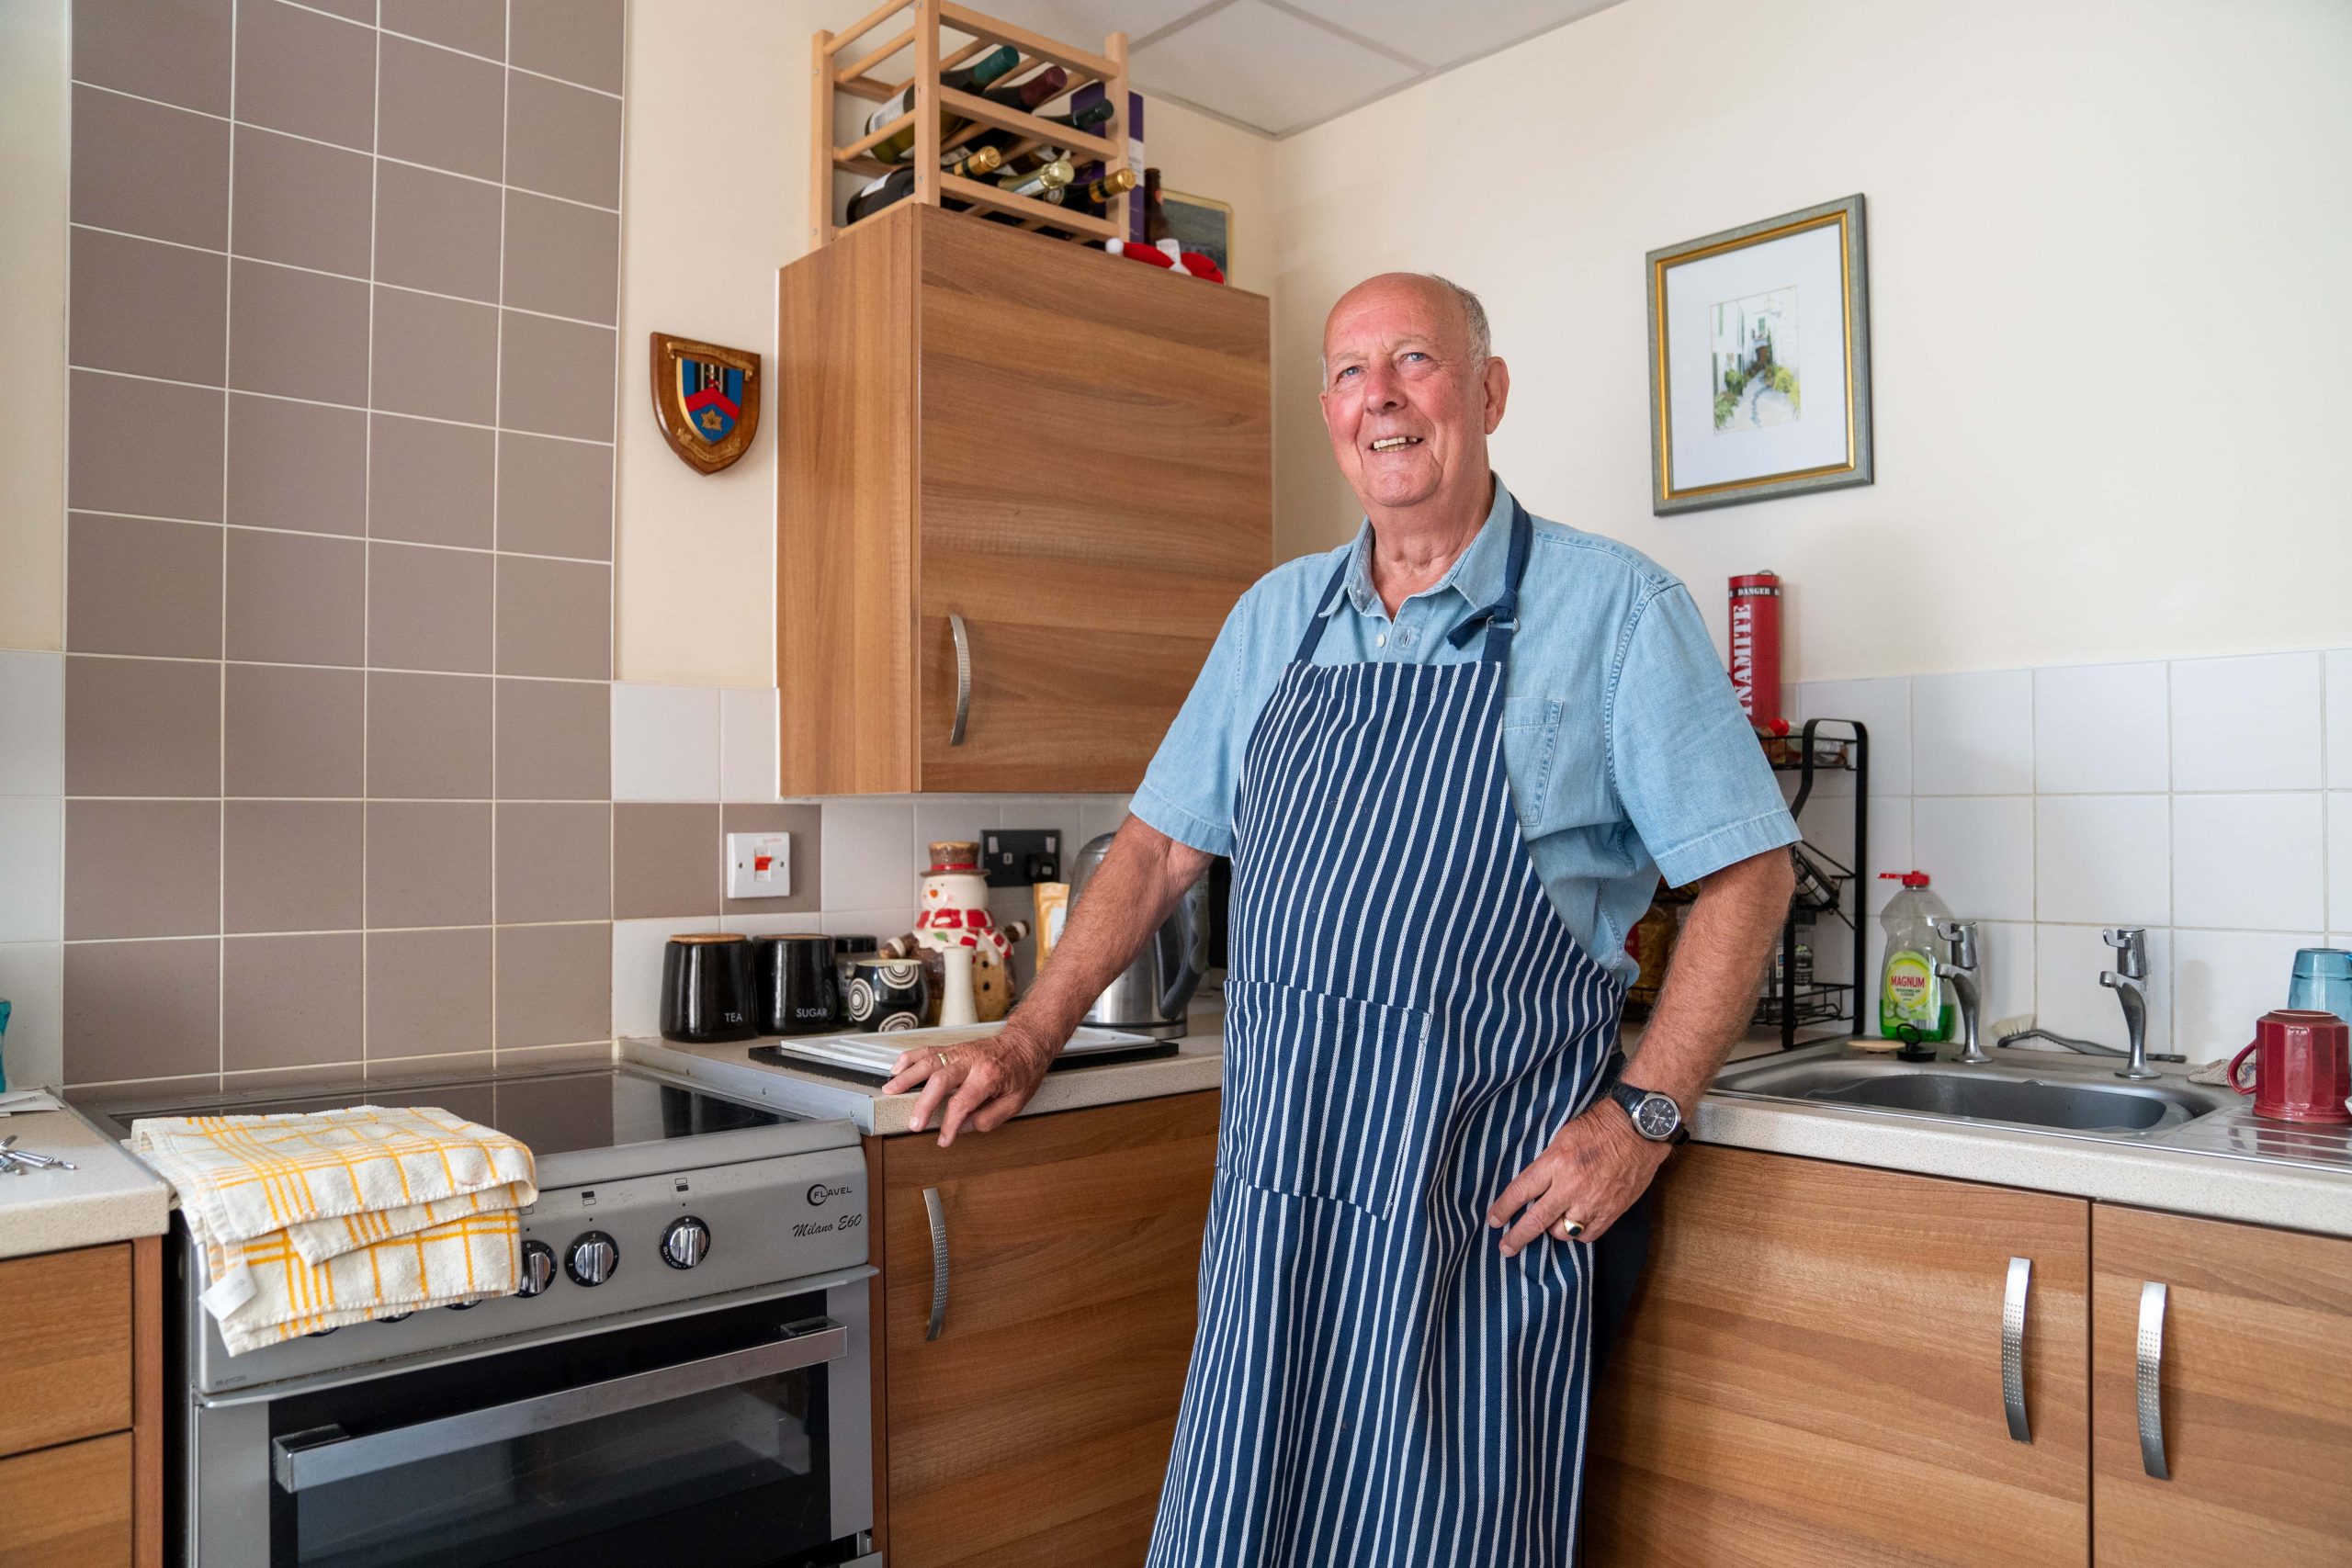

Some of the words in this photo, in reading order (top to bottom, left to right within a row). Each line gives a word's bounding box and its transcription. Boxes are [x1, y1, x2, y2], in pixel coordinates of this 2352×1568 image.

[1737, 587, 1770, 596] DANGER
[1891, 976, 1925, 987] MAGNUM
[724, 1012, 743, 1022] TEA
[796, 1008, 828, 1019] SUGAR
[814, 1186, 853, 1198] FLAVEL
[792, 1222, 833, 1237] Milano
[837, 1213, 863, 1231] E60
